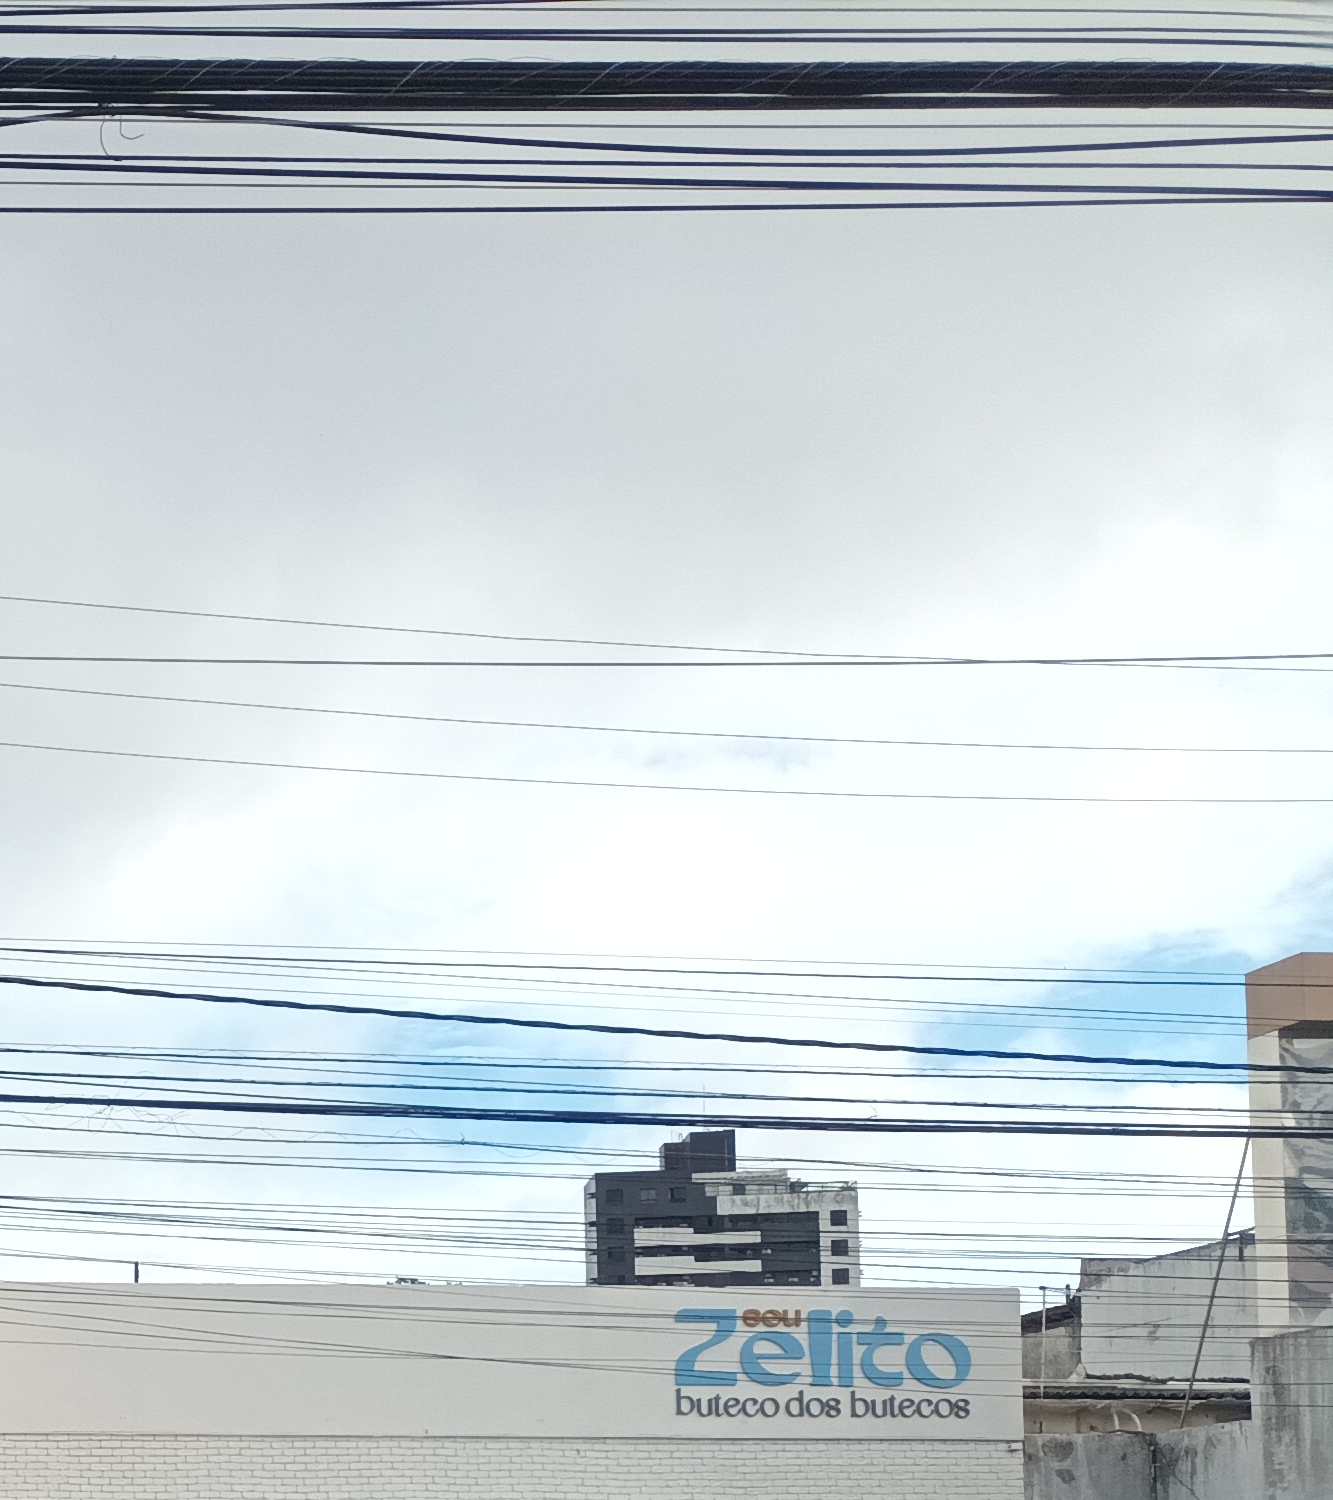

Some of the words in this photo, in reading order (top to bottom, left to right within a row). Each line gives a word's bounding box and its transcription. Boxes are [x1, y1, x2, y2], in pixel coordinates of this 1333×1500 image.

[675, 1309, 972, 1388] Zelito
[675, 1388, 780, 1417] buteco
[785, 1391, 841, 1417] dos
[850, 1391, 971, 1419] butecos
